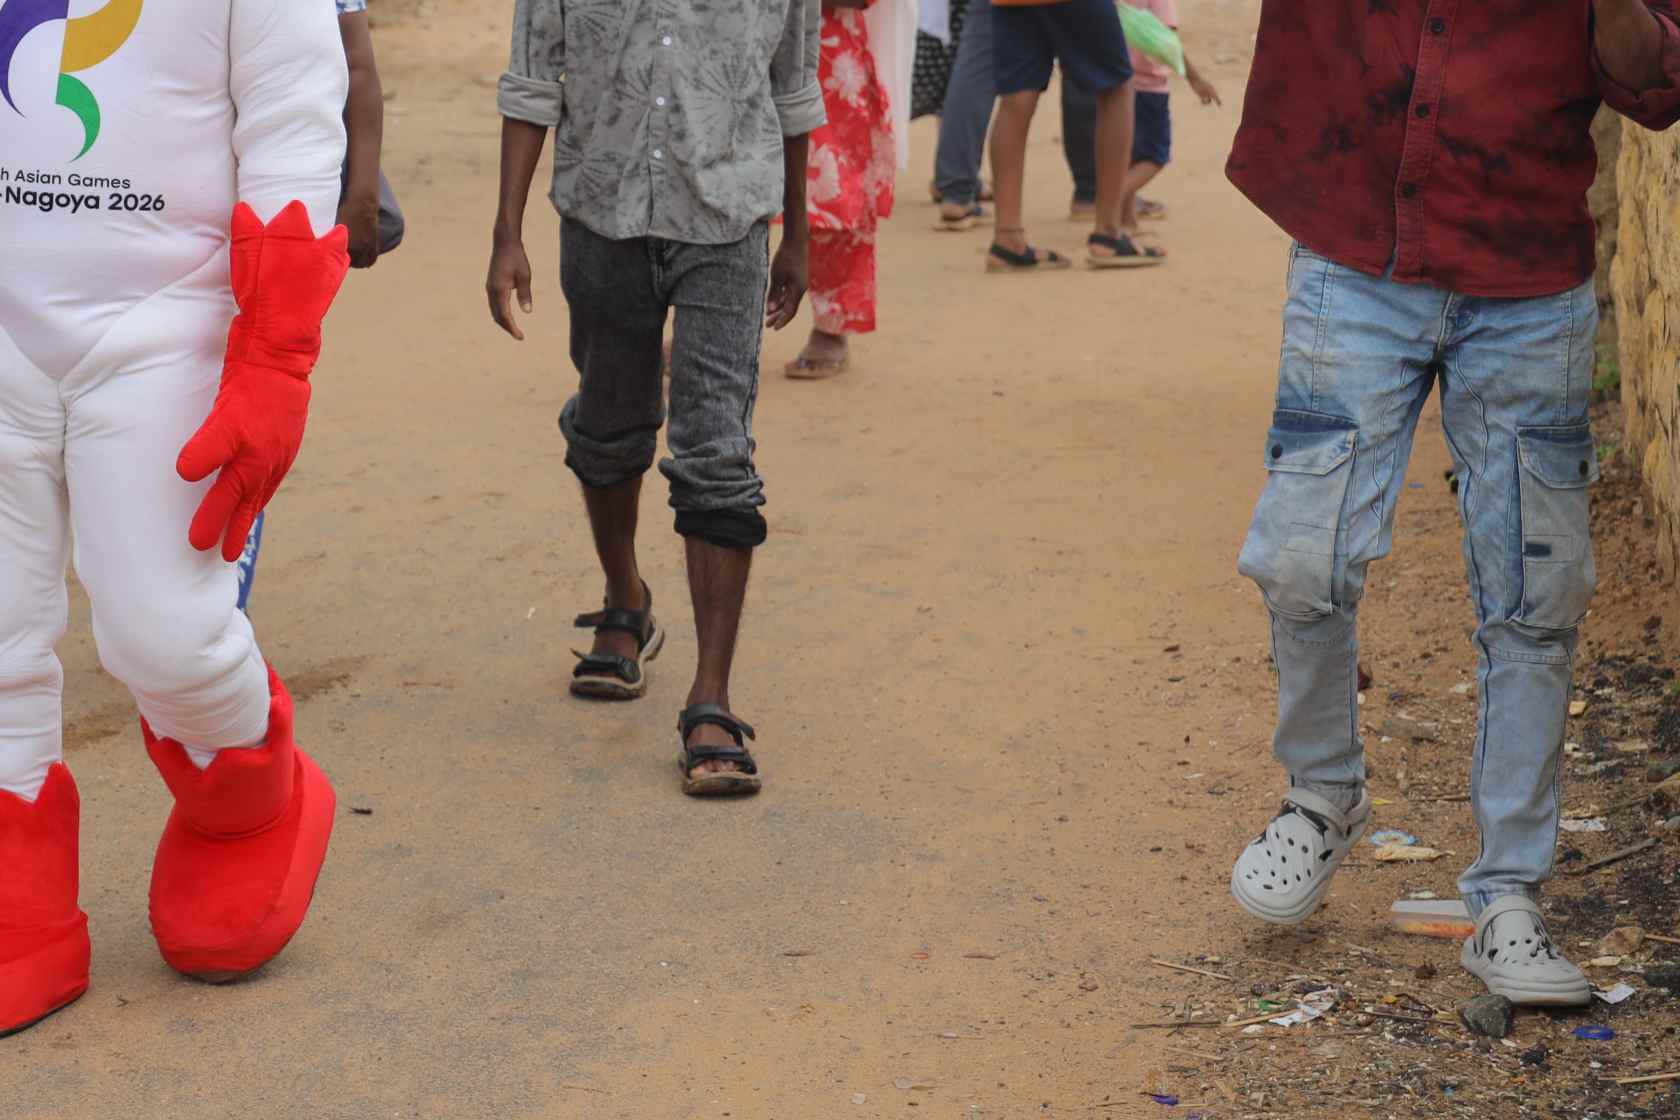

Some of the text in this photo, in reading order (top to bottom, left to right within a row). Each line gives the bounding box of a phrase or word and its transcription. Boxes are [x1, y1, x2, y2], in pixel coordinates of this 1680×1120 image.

[14, 168, 62, 185] Asian
[67, 173, 131, 189] Games
[107, 192, 166, 212] 2026
